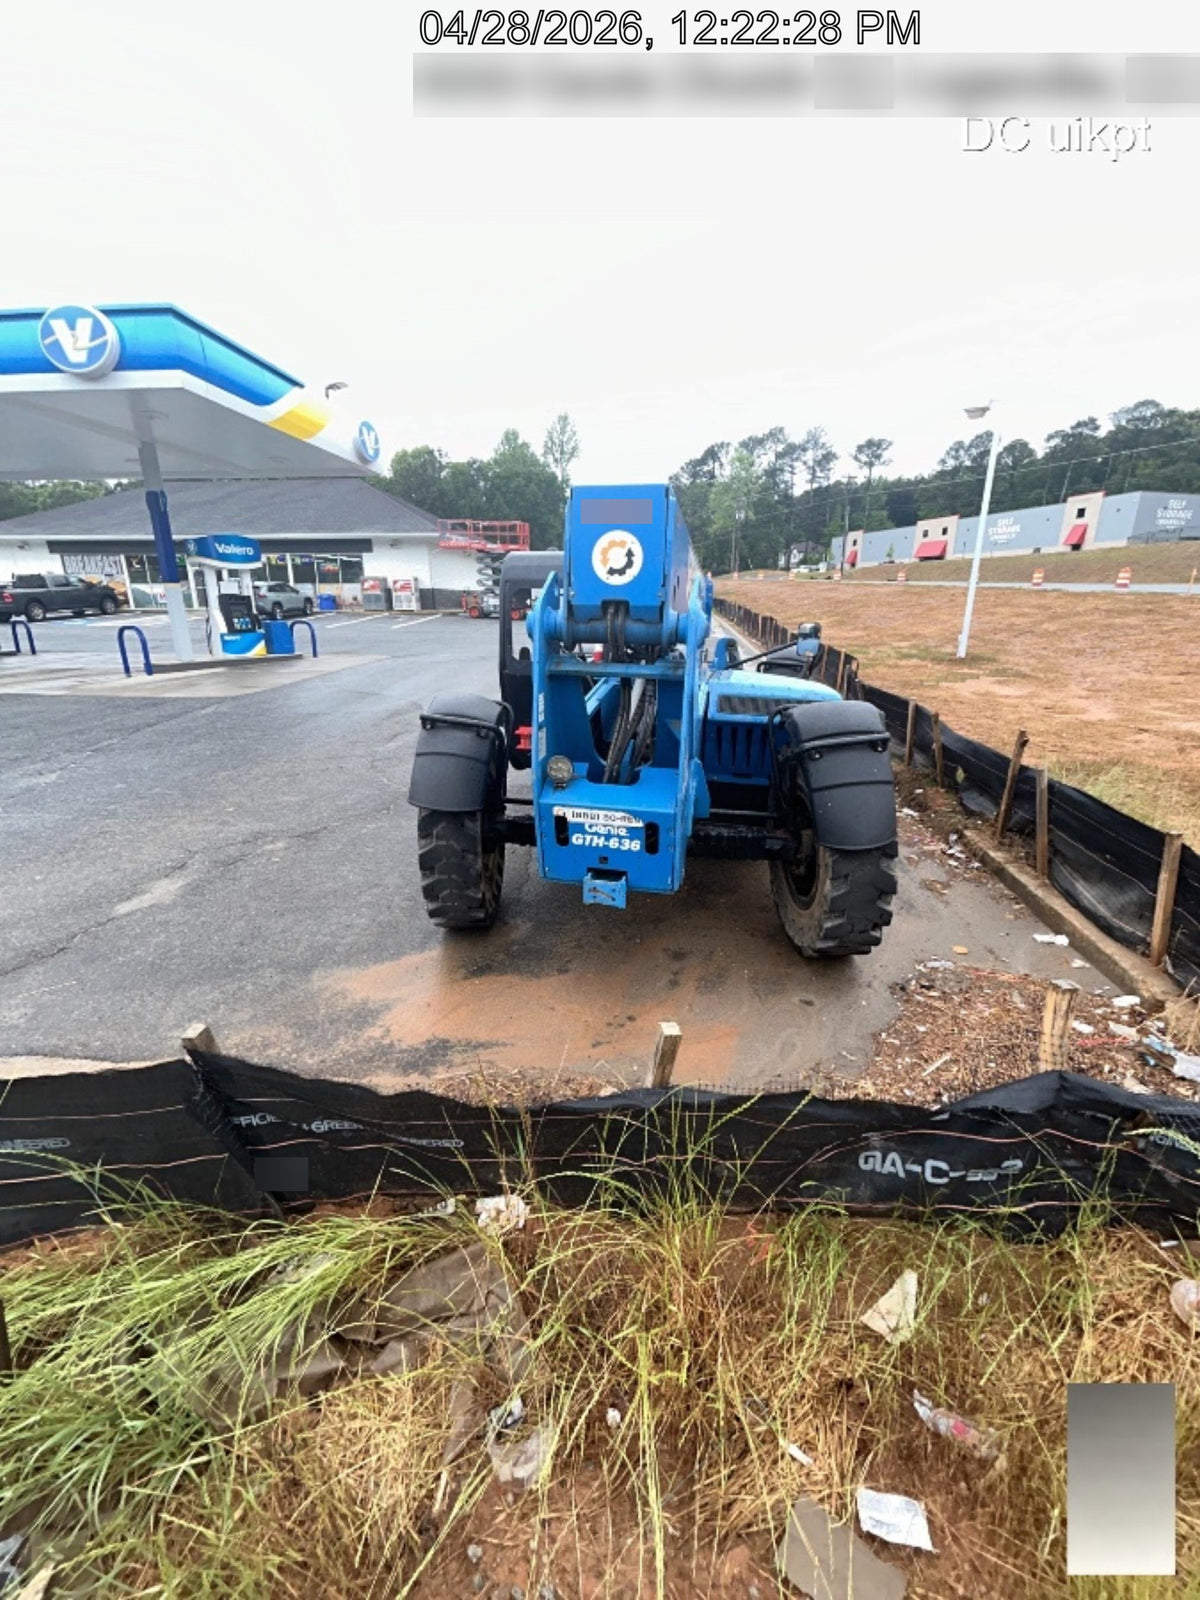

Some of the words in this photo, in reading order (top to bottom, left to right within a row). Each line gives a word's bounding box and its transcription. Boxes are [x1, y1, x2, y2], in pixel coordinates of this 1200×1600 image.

[213, 541, 255, 556] Valero
[584, 822, 630, 837] Genie
[571, 833, 641, 852] GTH-636
